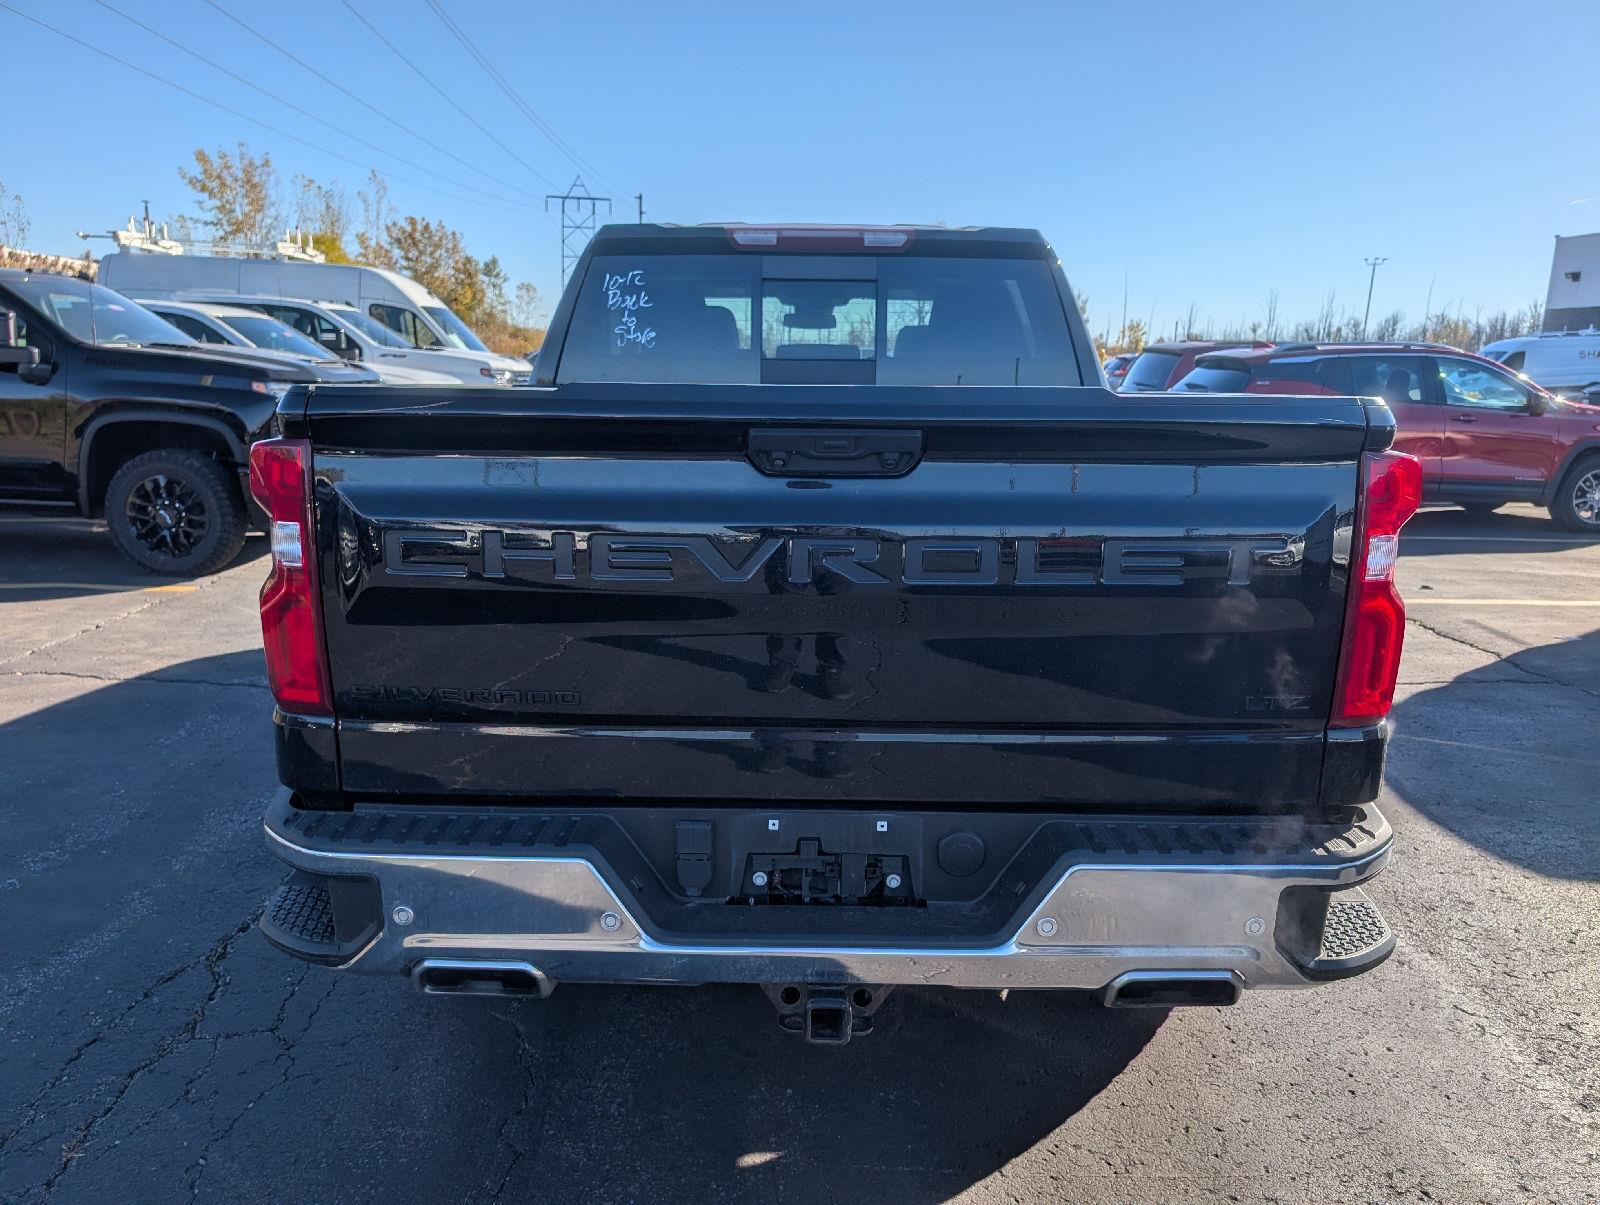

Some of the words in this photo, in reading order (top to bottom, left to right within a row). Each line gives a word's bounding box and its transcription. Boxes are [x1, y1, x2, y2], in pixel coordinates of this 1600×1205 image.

[622, 310, 637, 326] to
[614, 326, 657, 349] Store
[383, 528, 1304, 586] CHEVROLET
[350, 684, 582, 705] SILVERADO
